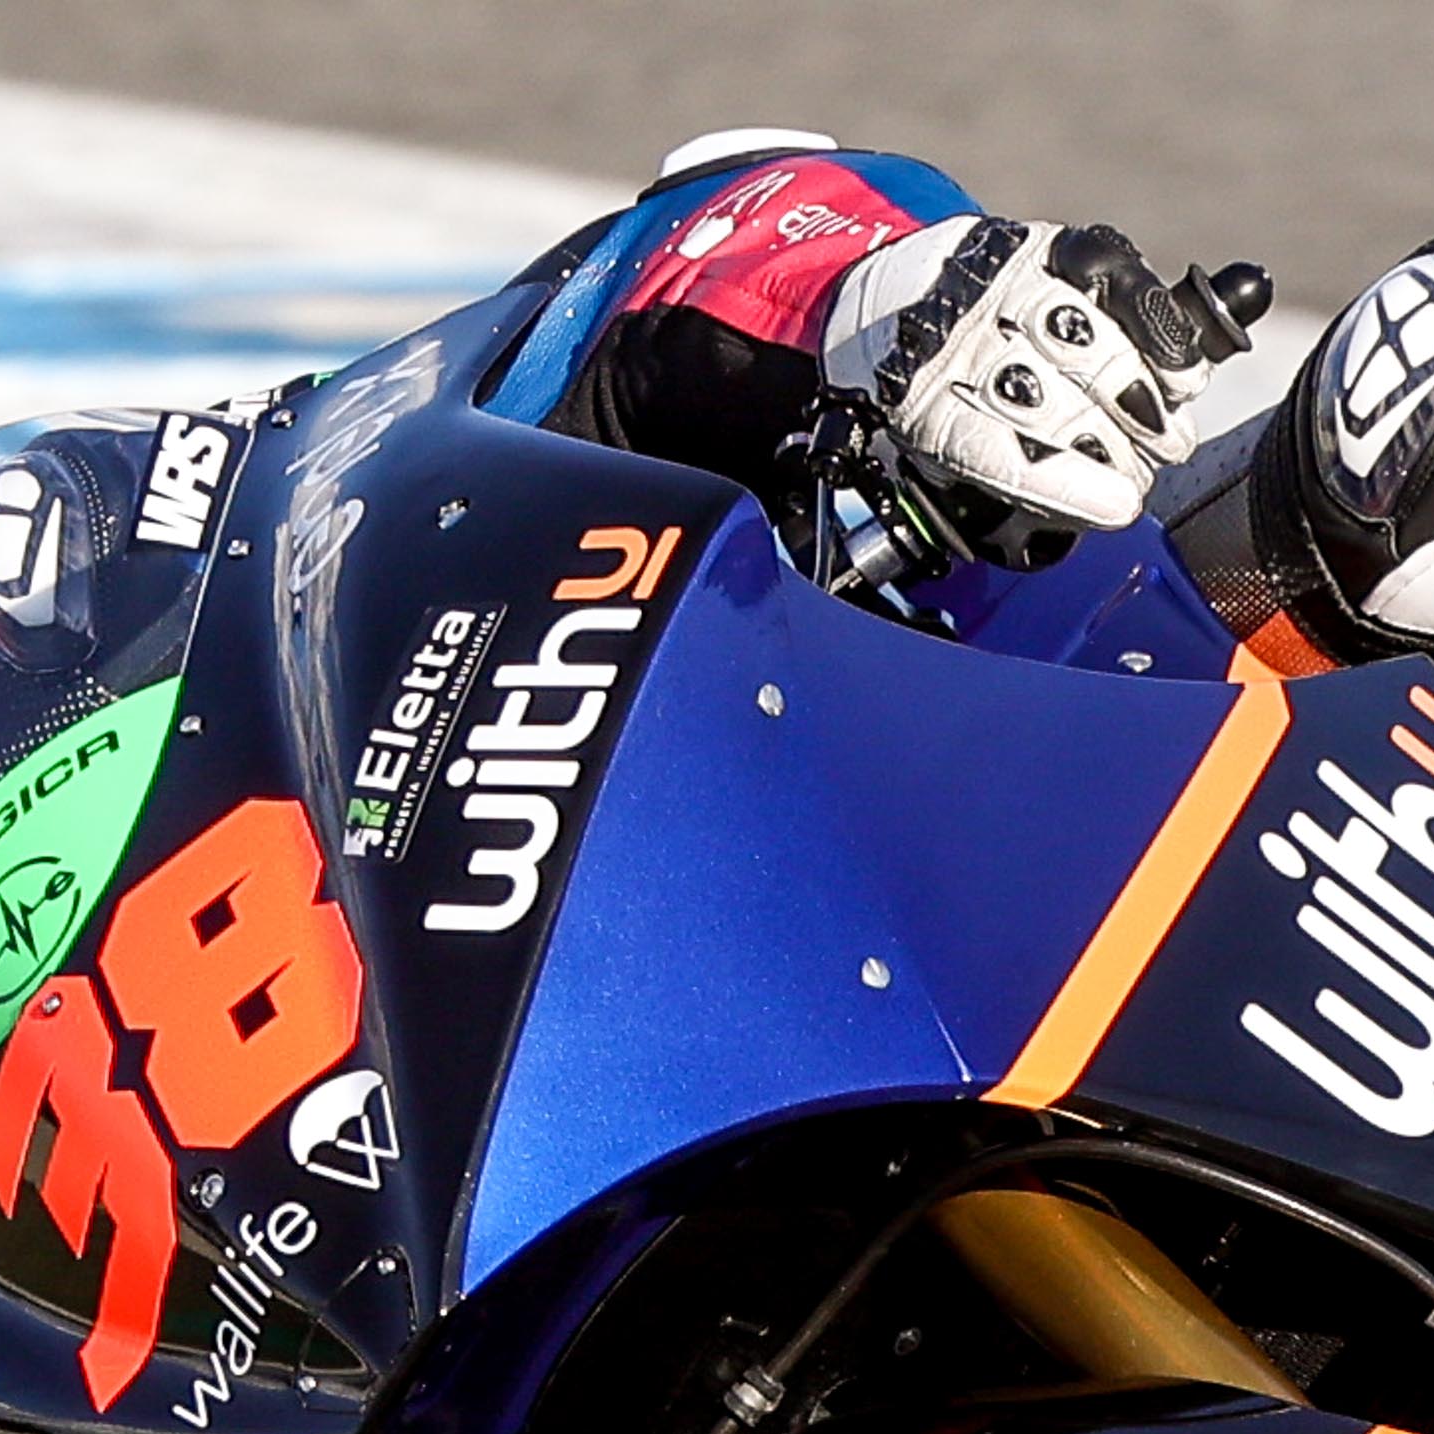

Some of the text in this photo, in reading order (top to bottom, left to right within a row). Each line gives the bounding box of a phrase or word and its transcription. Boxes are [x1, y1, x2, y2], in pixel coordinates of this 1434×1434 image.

[136, 412, 230, 549] WRS
[353, 610, 477, 793] Eletta
[383, 781, 422, 859] PROGETTA
[416, 710, 452, 772] INVESTE
[423, 526, 683, 932] withu
[172, 1199, 320, 1431] wallife
